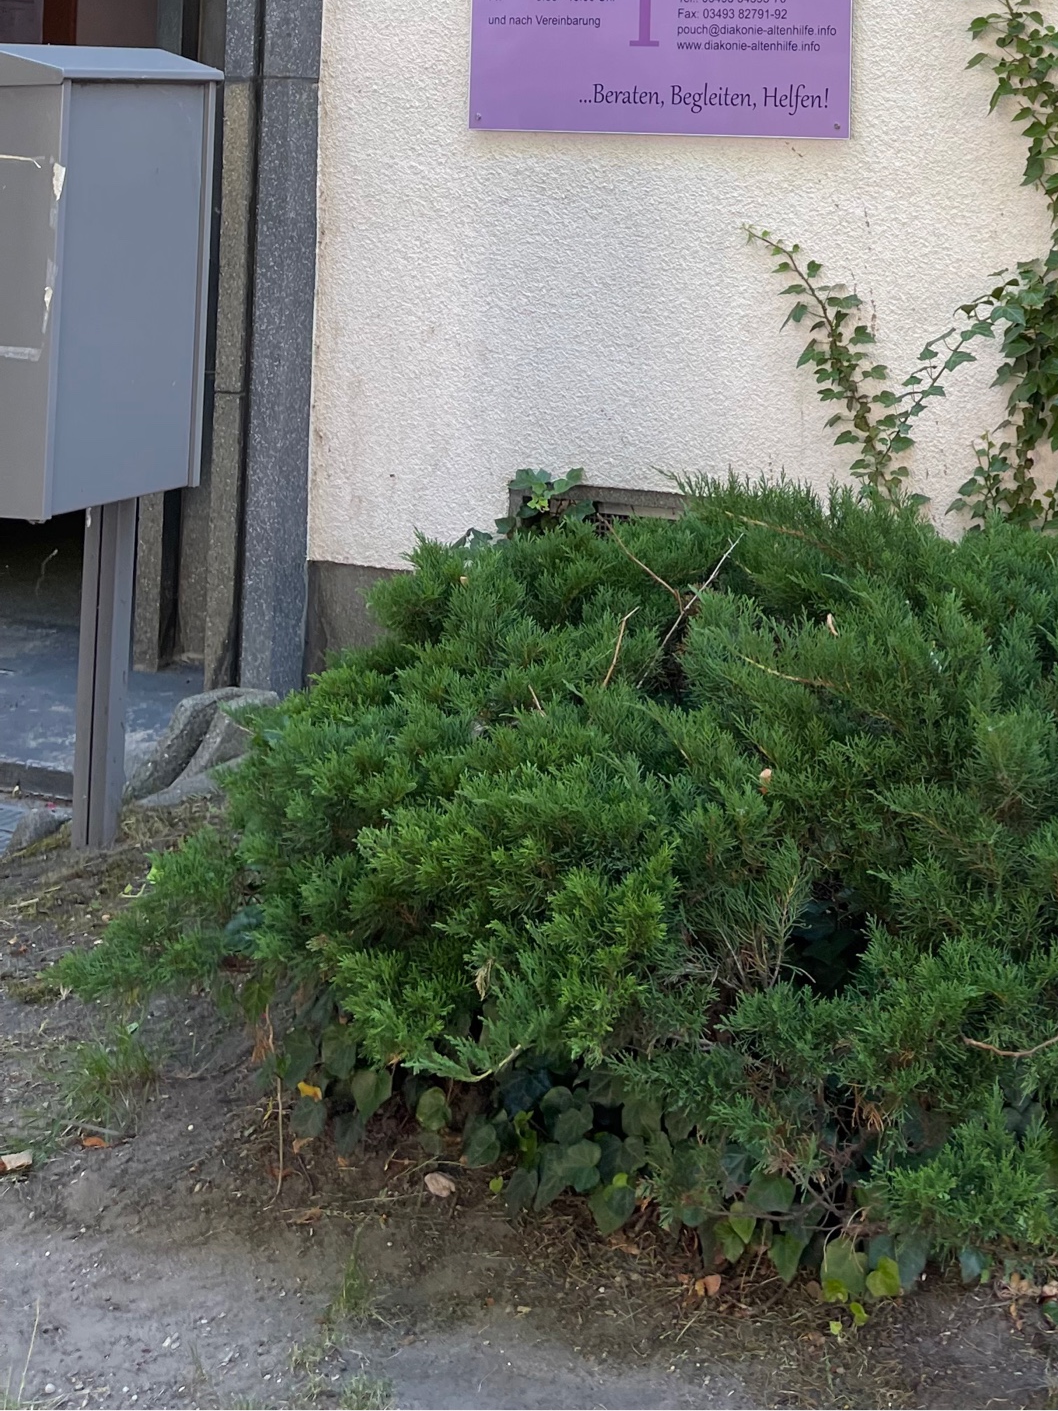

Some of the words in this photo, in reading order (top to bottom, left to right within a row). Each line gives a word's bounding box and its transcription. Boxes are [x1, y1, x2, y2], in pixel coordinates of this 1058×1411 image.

[677, 8, 699, 19] Fax:
[703, 8, 735, 19] 03493
[738, 8, 787, 19] 82791-92
[488, 15, 506, 25] und
[509, 15, 532, 25] nach
[535, 15, 601, 28] Vereinbarung
[677, 24, 837, 37] pouch@diakonie-altenhilfe.info
[677, 40, 821, 51] www.diakonie-altenhilfe.info
[579, 83, 665, 108] ...Beraten,
[671, 83, 757, 114] Begleiten,
[763, 84, 829, 115] Helfen!
